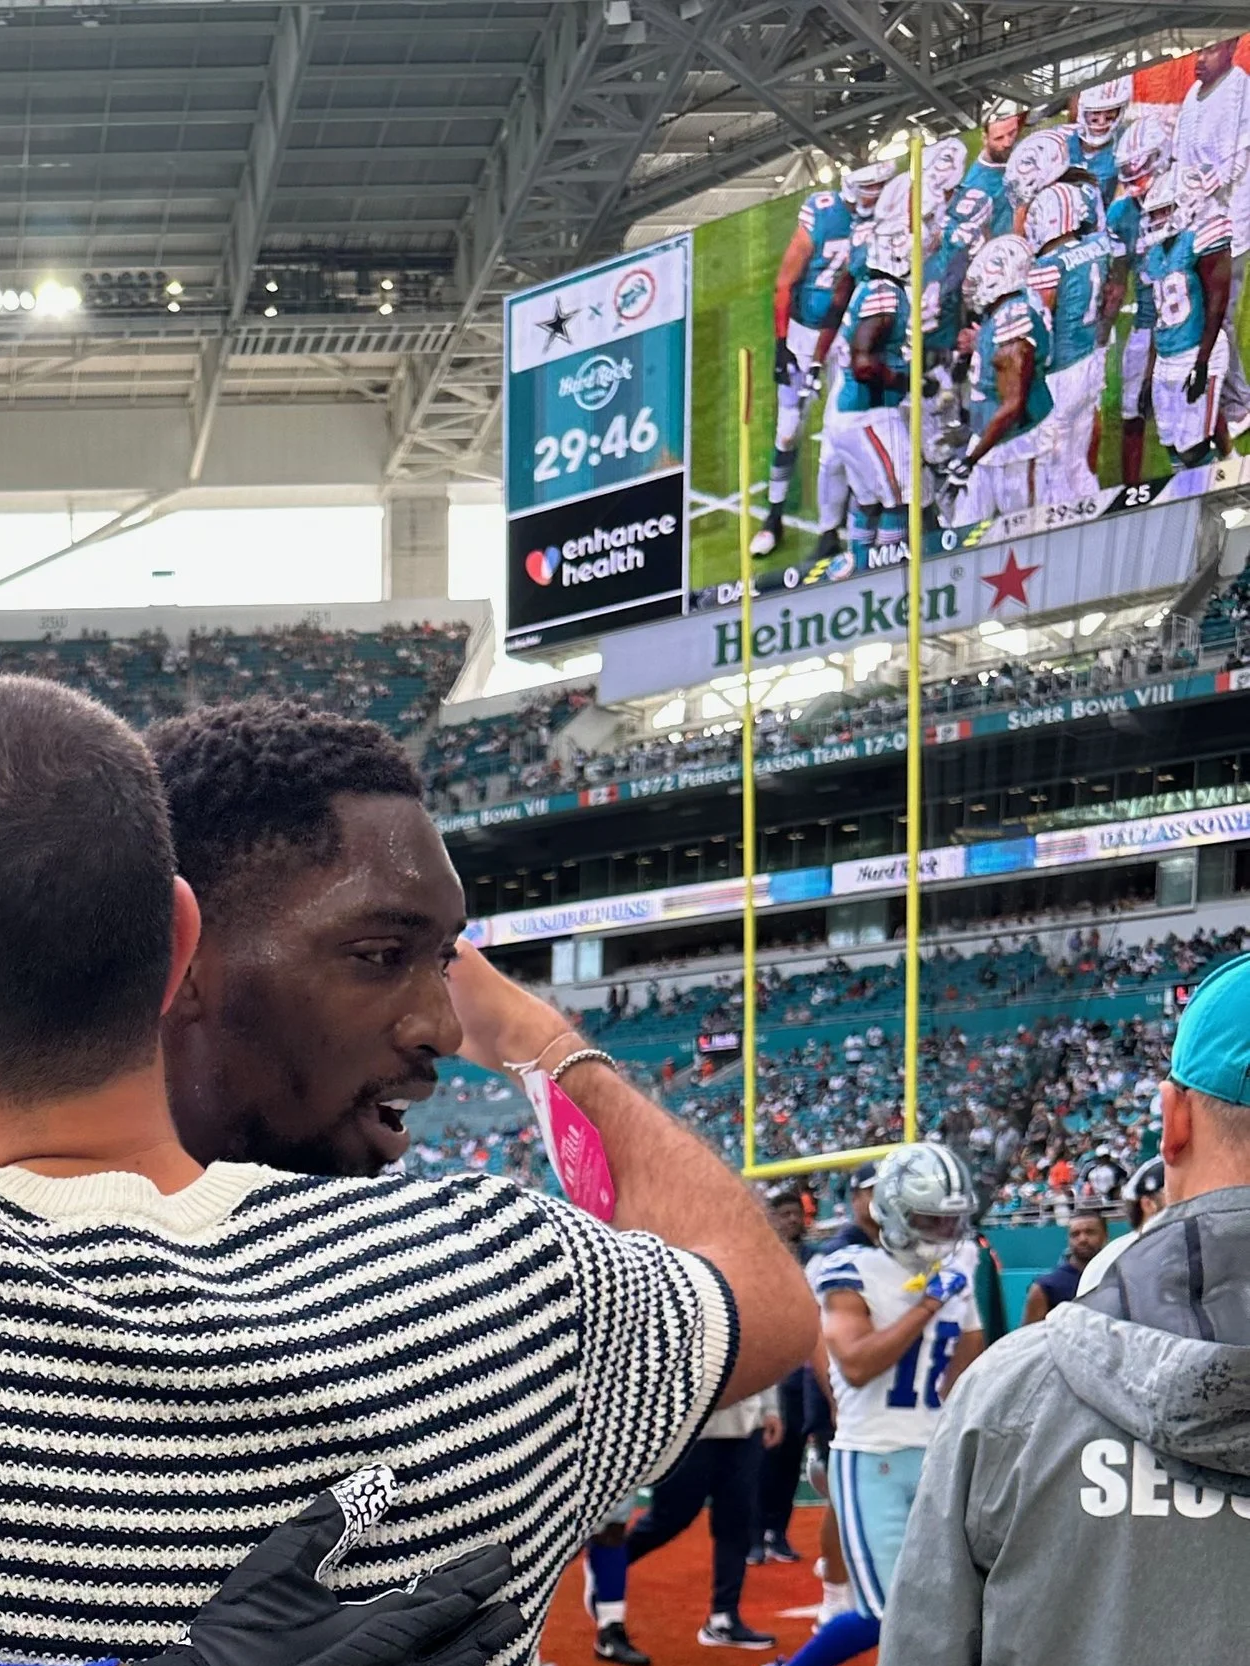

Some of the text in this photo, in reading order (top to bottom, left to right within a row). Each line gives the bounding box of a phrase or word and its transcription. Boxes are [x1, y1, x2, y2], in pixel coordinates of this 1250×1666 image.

[533, 406, 659, 483] 29:46
[1125, 484, 1151, 507] 25
[561, 513, 677, 561] enhance
[783, 567, 799, 588] 0
[941, 530, 958, 551] 0
[562, 546, 646, 587] health
[713, 583, 959, 668] Heineken
[1134, 683, 1175, 708] VIII
[630, 776, 675, 798] 1972
[753, 753, 809, 775] EASON
[864, 732, 908, 756] 17-0
